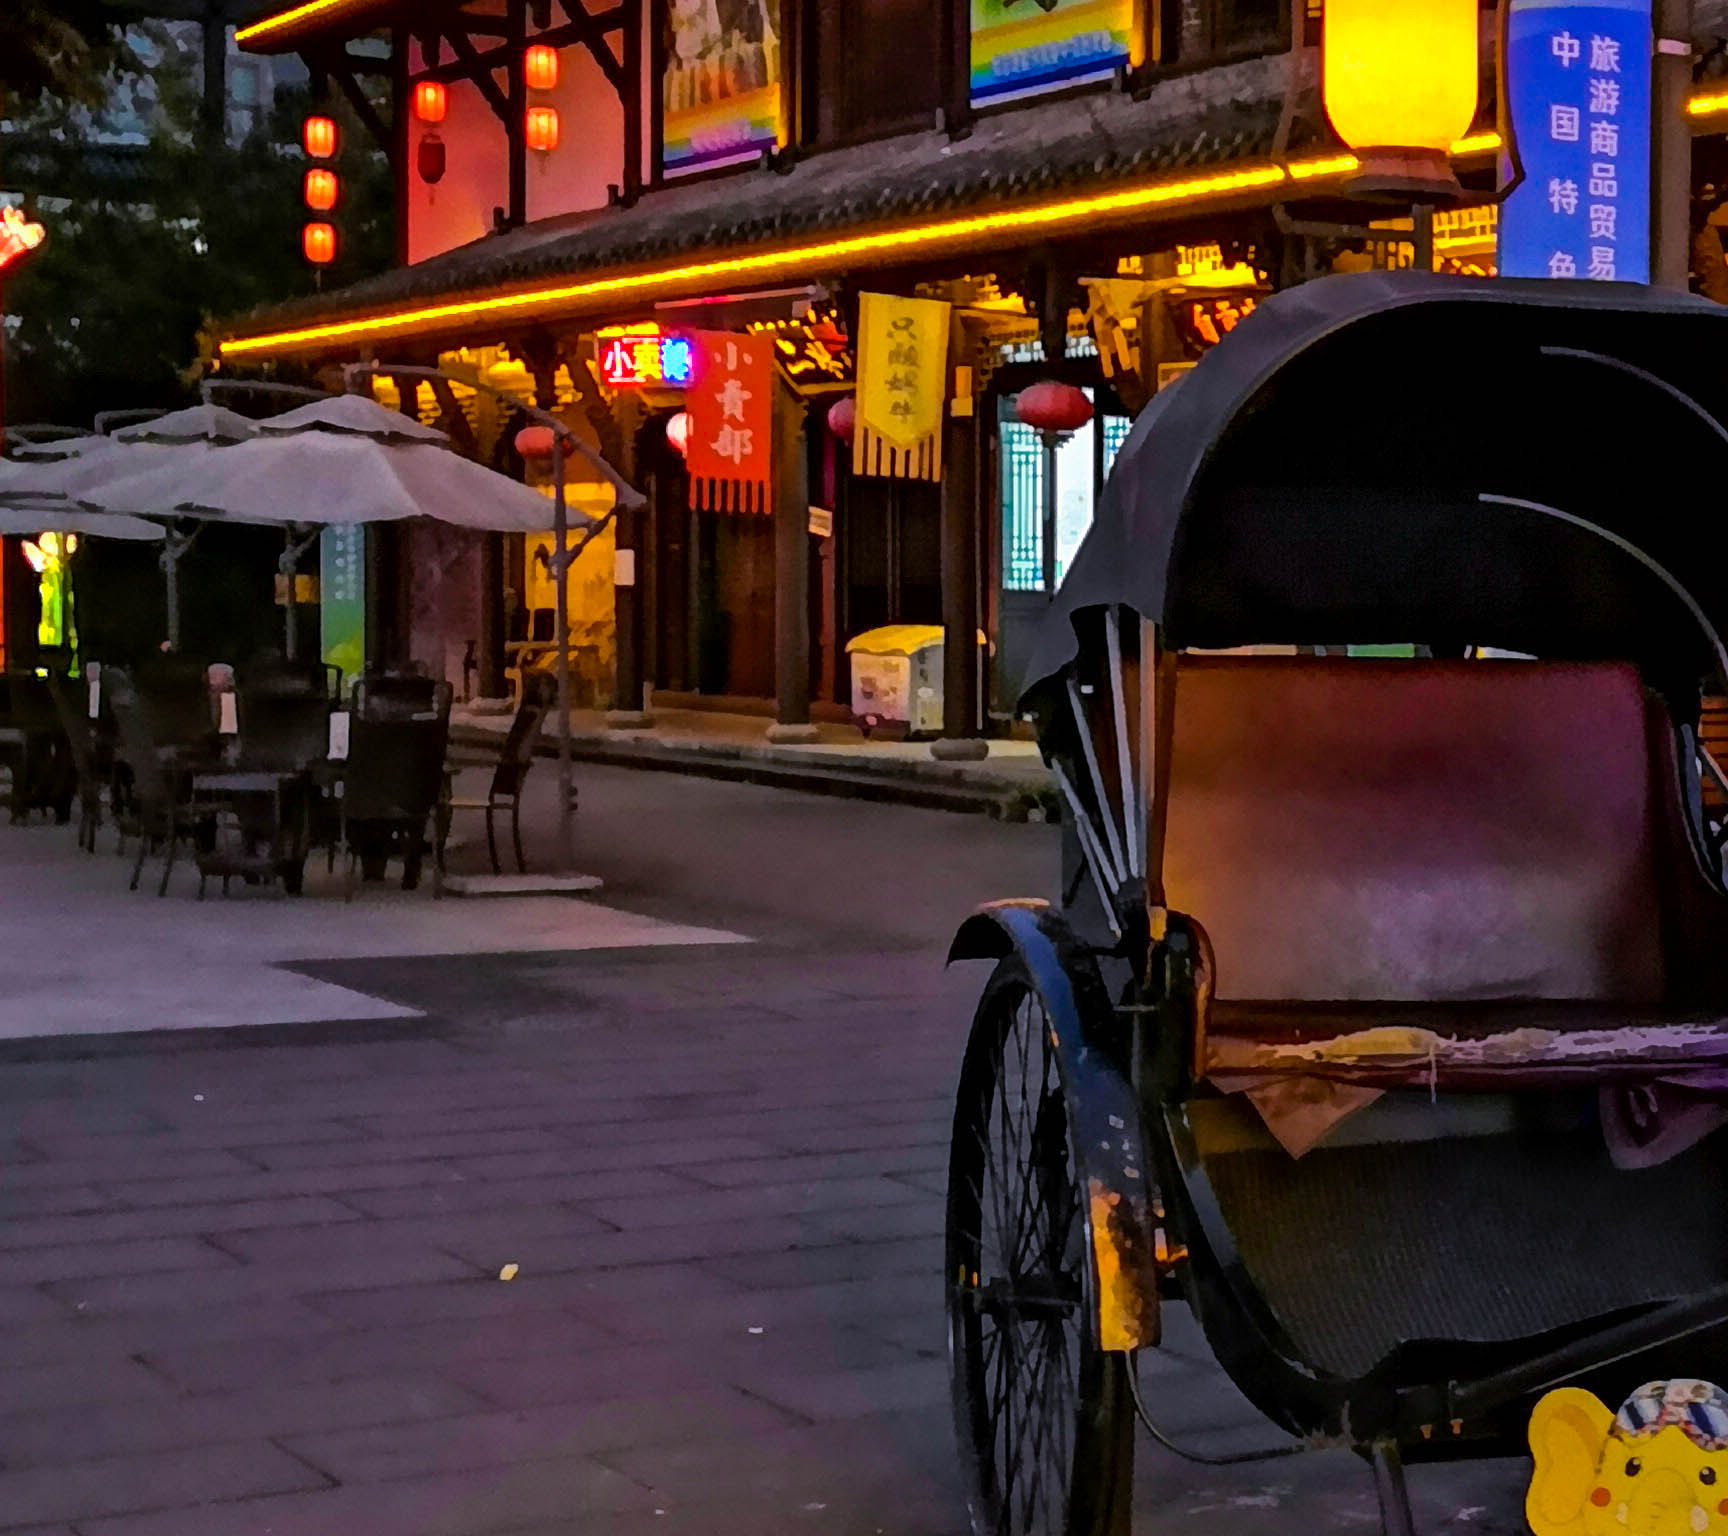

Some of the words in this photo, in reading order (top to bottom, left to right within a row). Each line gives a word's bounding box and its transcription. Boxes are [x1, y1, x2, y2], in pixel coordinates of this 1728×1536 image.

[1547, 31, 1581, 279] 中国特色
[1587, 34, 1622, 281] 旅游商品贸易
